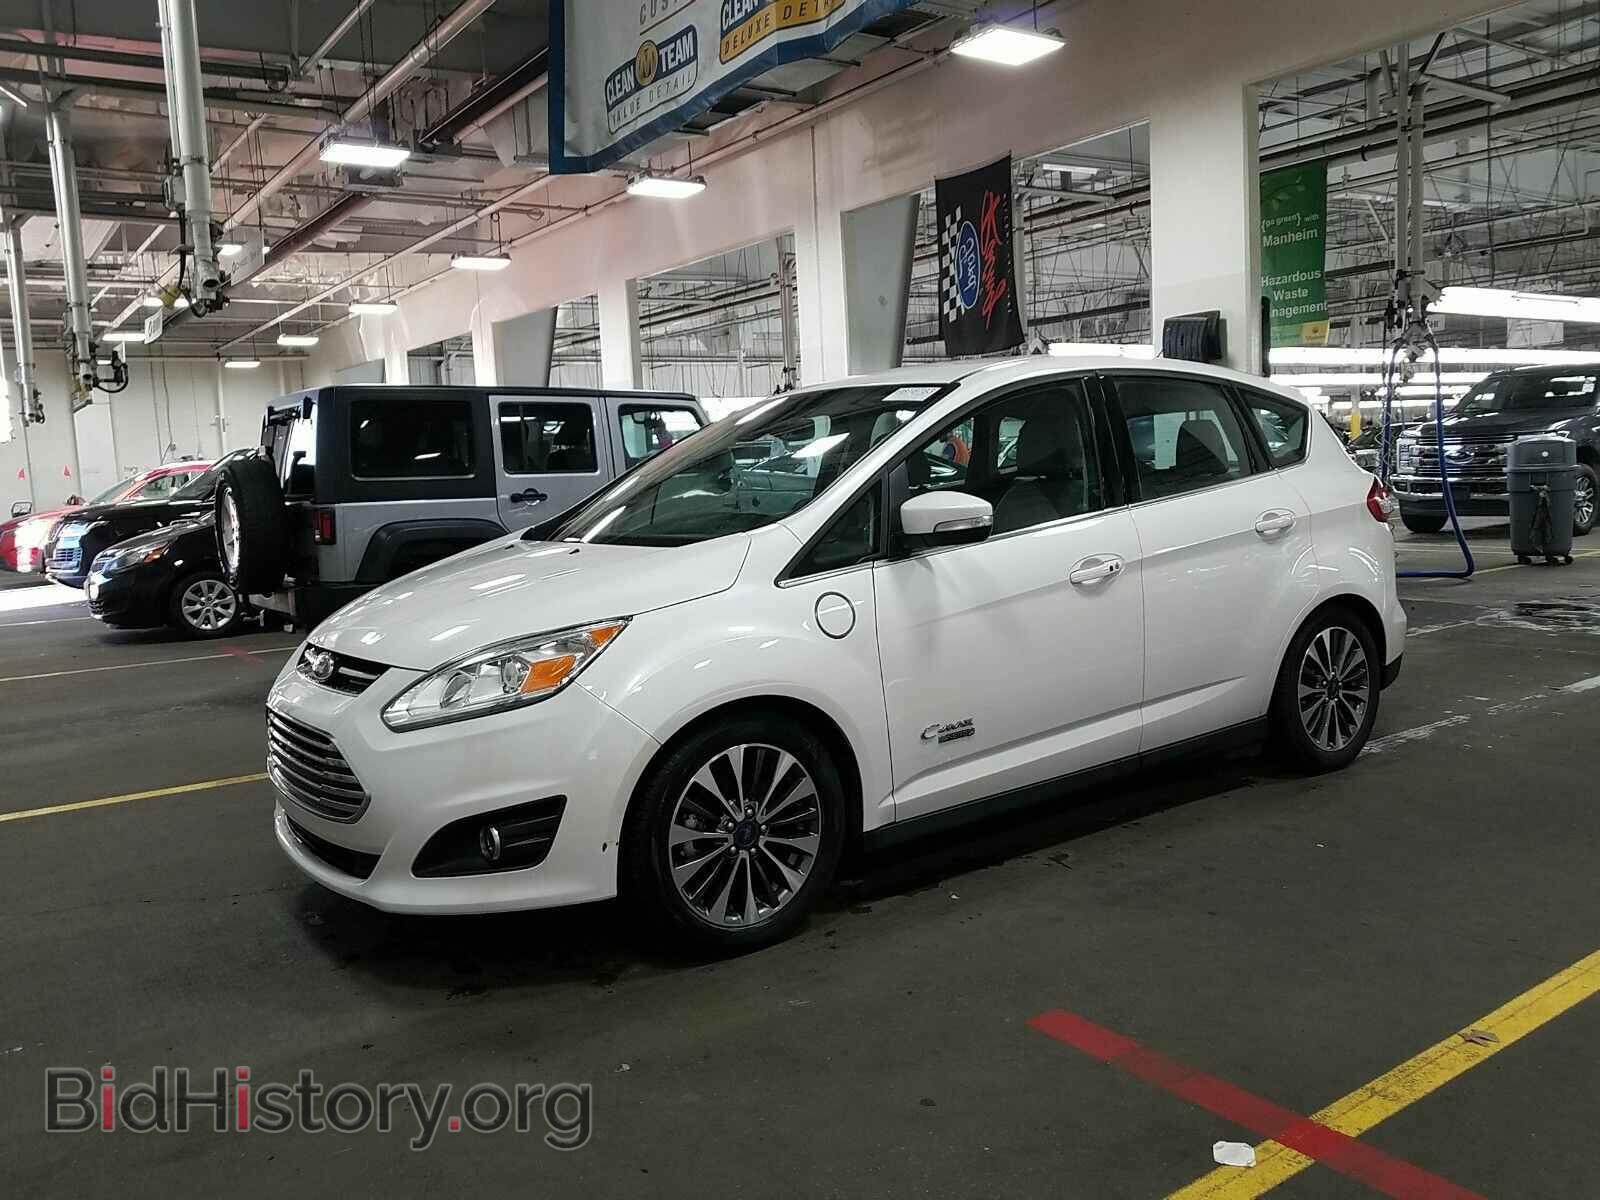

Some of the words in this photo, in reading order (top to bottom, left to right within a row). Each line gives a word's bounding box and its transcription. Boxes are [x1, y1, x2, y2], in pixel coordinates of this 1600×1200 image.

[640, 0, 679, 25] CUS
[721, 0, 759, 31] CLEA
[724, 13, 770, 56] DELUXE
[783, 0, 832, 20] DETA
[606, 64, 635, 106] CLEAN
[660, 31, 694, 73] TEAM
[610, 97, 640, 127] VALUE
[648, 71, 693, 103] DETAIL
[1263, 228, 1318, 247] Manheim
[1261, 270, 1322, 287] Hazardous
[1273, 288, 1309, 301] Waste
[1271, 300, 1329, 318] nagement
